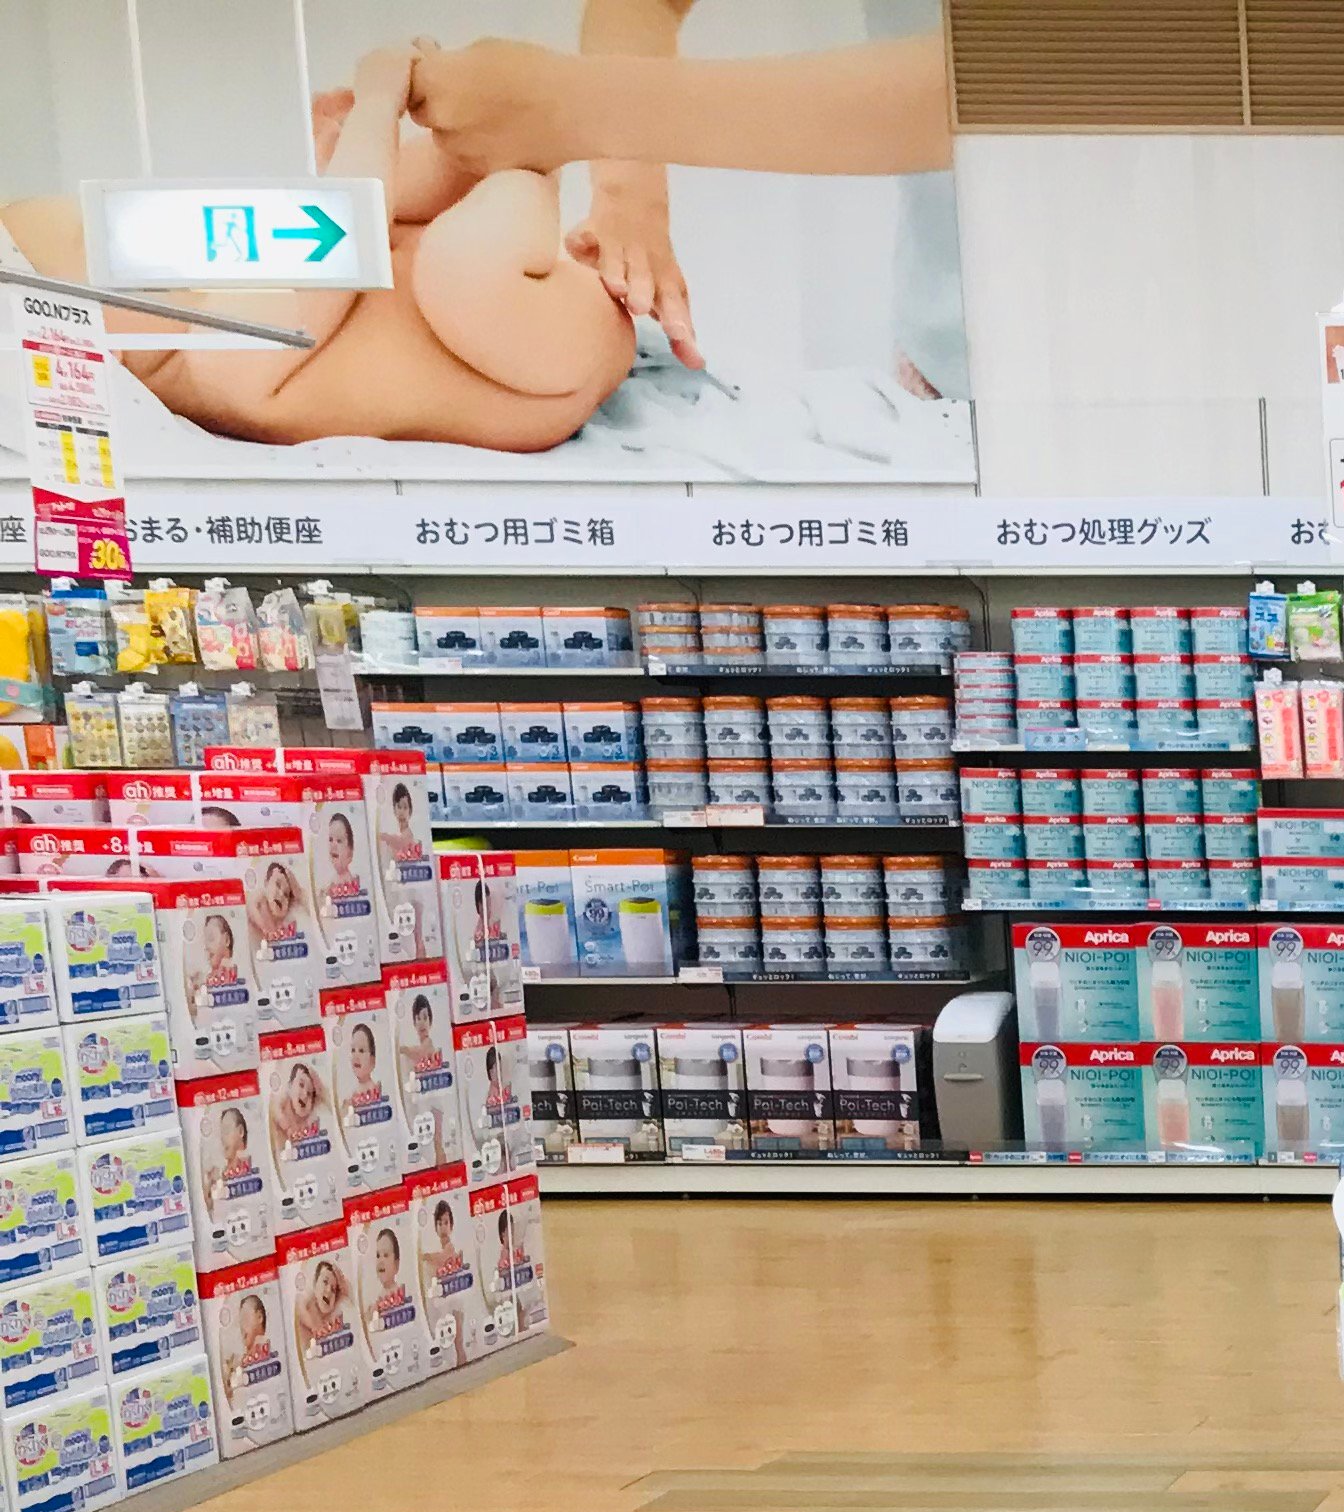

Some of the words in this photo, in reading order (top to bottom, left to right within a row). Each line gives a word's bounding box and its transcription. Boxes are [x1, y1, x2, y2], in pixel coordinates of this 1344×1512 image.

[416, 518, 616, 547] おむつ用ゴミ箱
[712, 519, 909, 549] おむつ用ゴミ箱
[996, 517, 1212, 548] おむつ処理グッズ
[1206, 930, 1249, 944] Aprica
[1210, 1048, 1254, 1063] Aprica
